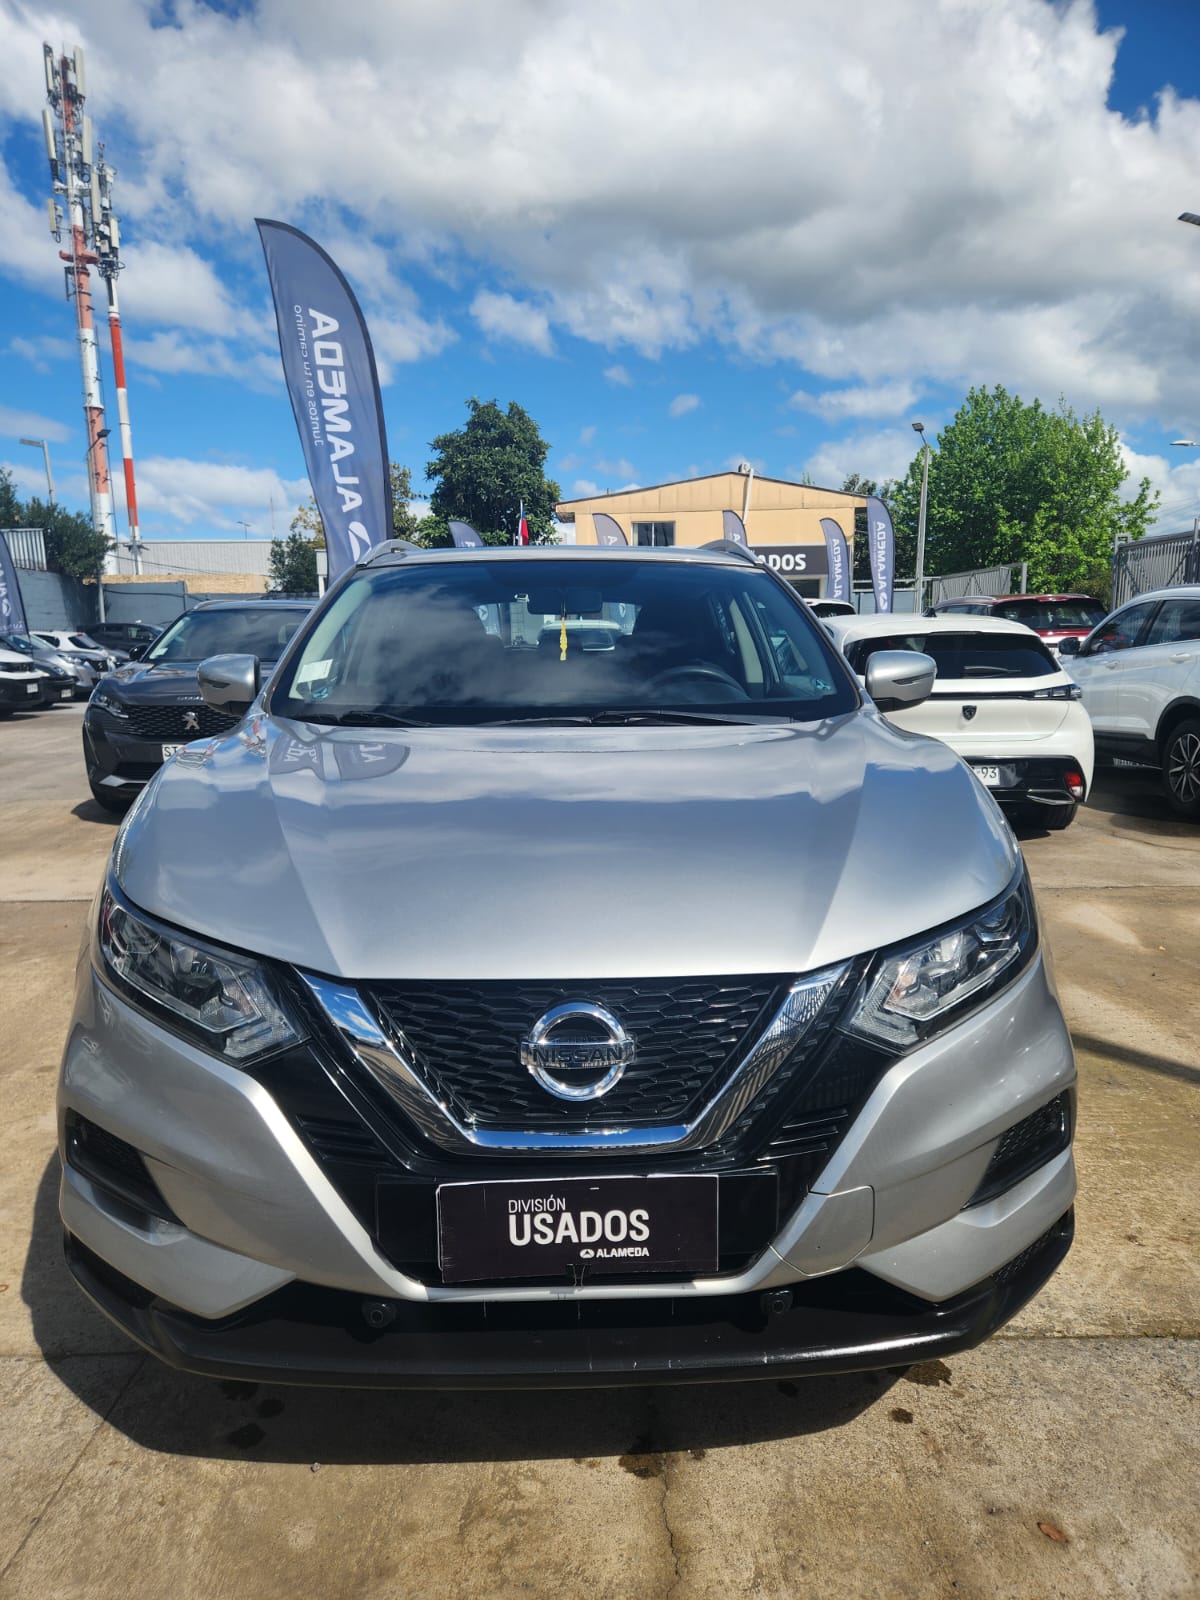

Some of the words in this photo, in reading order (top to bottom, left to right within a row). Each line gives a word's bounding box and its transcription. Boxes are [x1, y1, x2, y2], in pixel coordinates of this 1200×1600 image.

[533, 1045, 622, 1062] NISSAN
[508, 1194, 566, 1214] DIVISIÓN
[508, 1209, 650, 1247] USADOS
[596, 1246, 650, 1258] ALAMEDA
